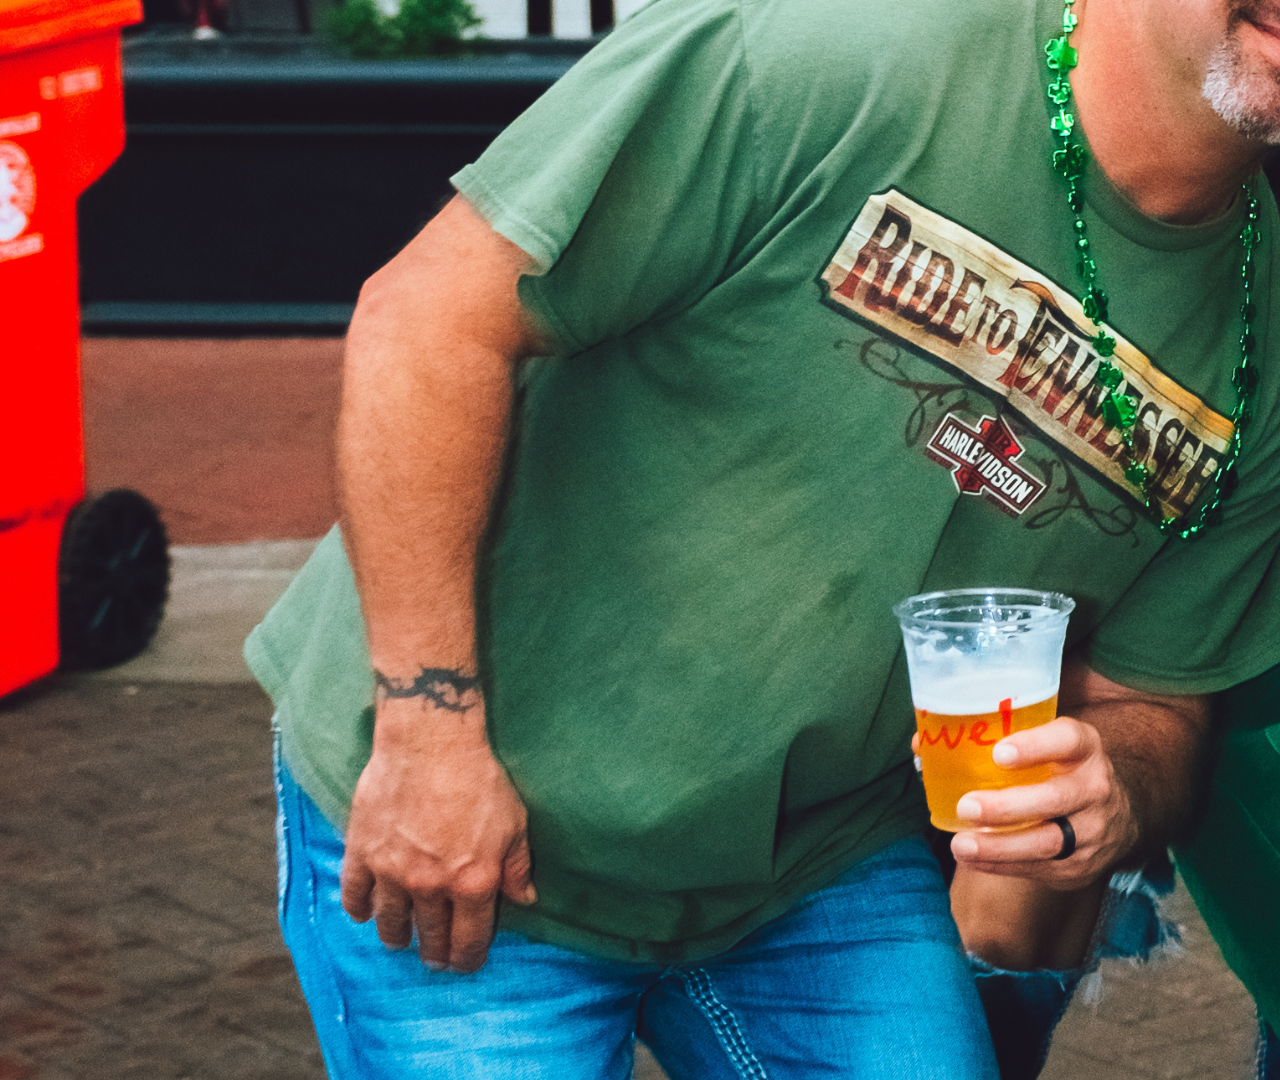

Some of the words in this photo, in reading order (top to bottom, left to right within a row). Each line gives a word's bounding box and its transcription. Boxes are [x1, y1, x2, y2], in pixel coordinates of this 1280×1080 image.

[834, 203, 987, 347] RIDE
[969, 295, 1019, 355] TO
[919, 697, 1013, 749] ive!
